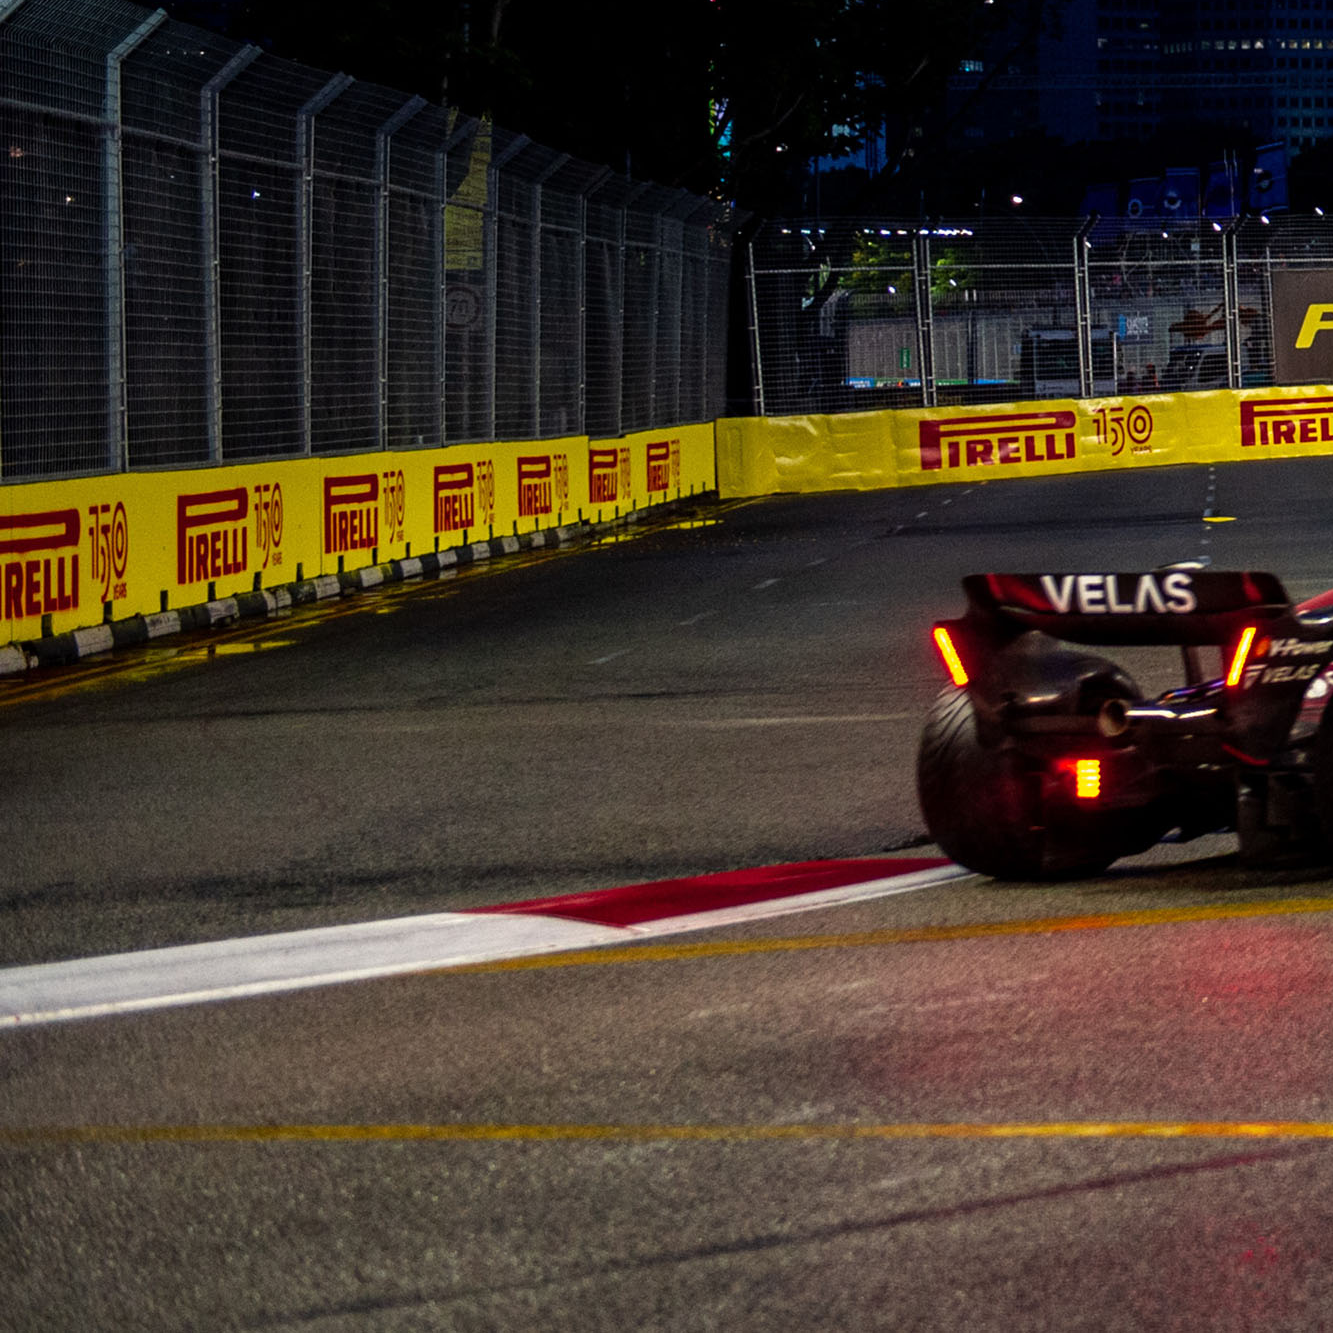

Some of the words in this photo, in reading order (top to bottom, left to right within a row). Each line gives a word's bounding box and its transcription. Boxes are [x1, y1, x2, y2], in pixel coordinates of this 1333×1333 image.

[919, 410, 1076, 470] PIRELLI
[1092, 405, 1153, 456] 150
[324, 474, 379, 554] PIRELLI
[383, 469, 406, 545] 150
[434, 462, 474, 533] PIRELLI
[517, 455, 552, 516] PIRELLI
[89, 501, 128, 604] 150
[178, 487, 249, 585] PIRELLI
[255, 482, 284, 569] 150
[1039, 571, 1198, 615] VELAS
